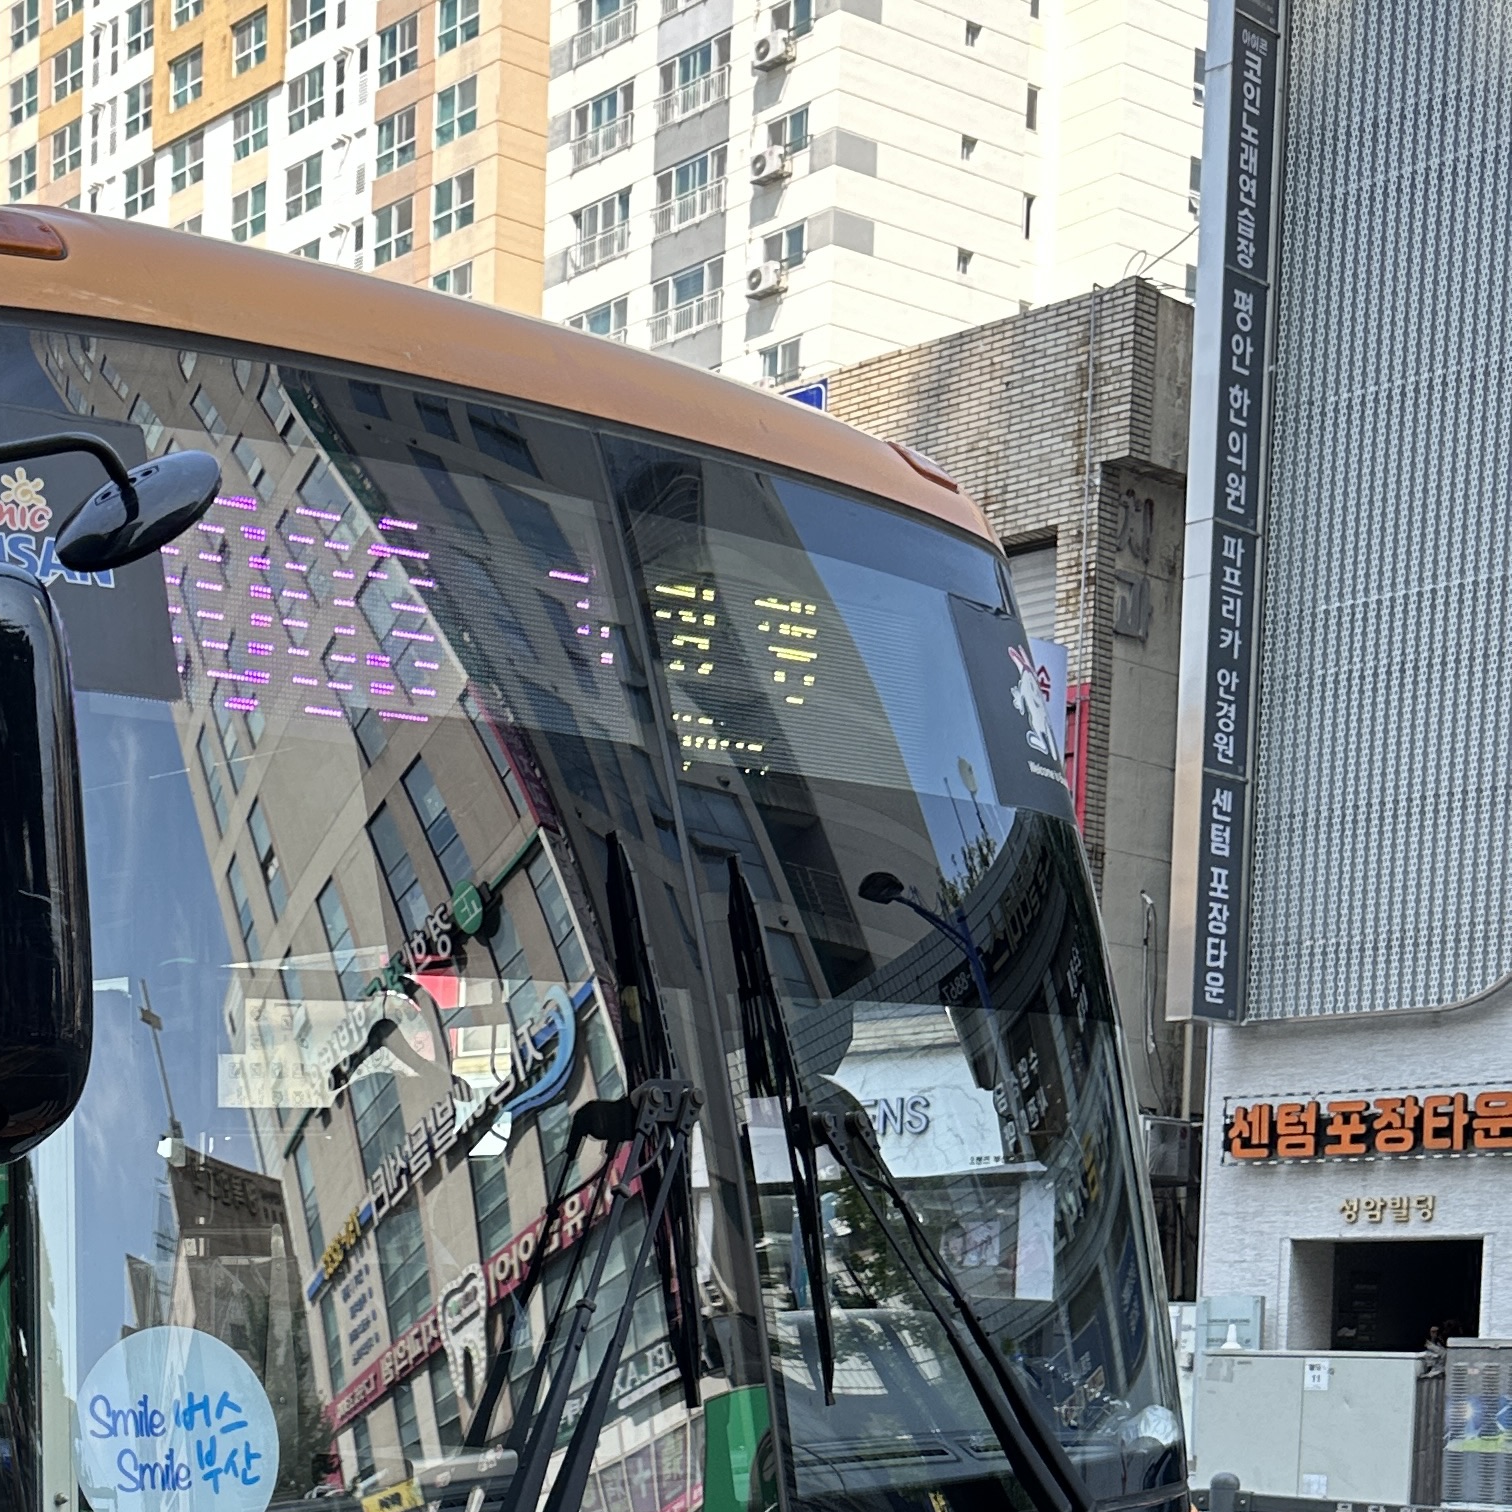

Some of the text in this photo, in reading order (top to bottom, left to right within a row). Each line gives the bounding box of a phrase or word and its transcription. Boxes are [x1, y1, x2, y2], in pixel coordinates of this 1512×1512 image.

[1213, 534, 1246, 768] 파프리카 안경원
[1228, 1091, 1512, 1161] 센텀포장타운
[1339, 1194, 1437, 1224] 성암빌딩
[89, 1391, 248, 1440] Smile 버스
[117, 1435, 263, 1495] Smile 부산
